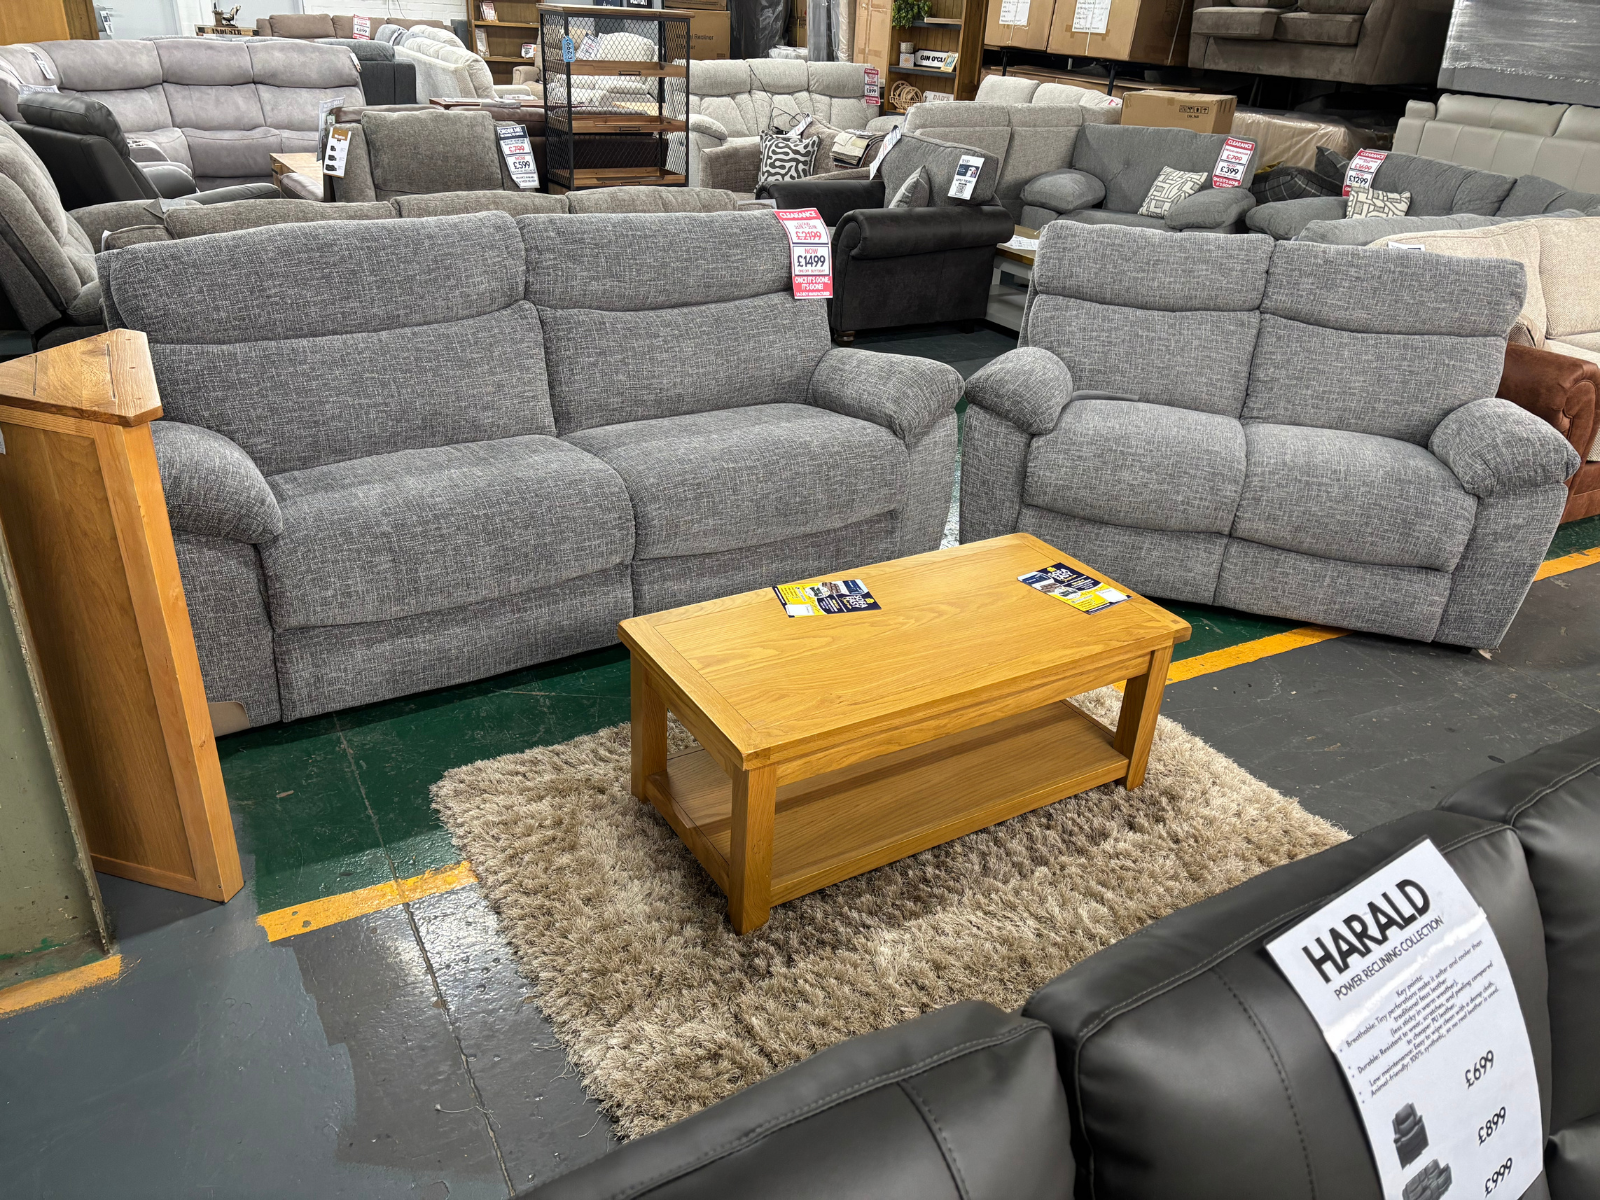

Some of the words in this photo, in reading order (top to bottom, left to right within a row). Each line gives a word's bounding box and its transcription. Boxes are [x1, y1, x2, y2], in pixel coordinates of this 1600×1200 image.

[1228, 140, 1252, 149] CLEARANCE
[513, 161, 530, 169] £599
[1221, 166, 1239, 175] £399
[1349, 175, 1368, 185] £1299
[1354, 163, 1372, 171] £1699
[796, 231, 821, 240] £2199
[797, 255, 825, 267] £1499
[1302, 879, 1430, 984] HARALD
[1334, 974, 1367, 1000] POWER
[1362, 946, 1403, 980] RECLINING
[1400, 916, 1444, 952] COLLECTION
[1346, 1022, 1377, 1048] Breathable:
[1375, 1014, 1388, 1024] Tiny
[1388, 991, 1417, 1018] perforations
[1418, 981, 1431, 993] make
[1435, 967, 1448, 979] softer
[1449, 957, 1458, 969] and
[1458, 948, 1471, 961] cooler
[1472, 940, 1483, 950] than
[1394, 998, 1419, 1022] traditional
[1419, 992, 1431, 1002] faux
[1430, 978, 1447, 993] leather
[1396, 988, 1407, 998] Key
[1407, 975, 1423, 992] points:
[1358, 1054, 1380, 1074] Durable:
[1380, 1034, 1403, 1056] Resistant
[1409, 1020, 1423, 1032] wear,
[1423, 1002, 1445, 1021] scratches,
[1446, 991, 1455, 1003] and
[1455, 980, 1472, 997] peeling
[1472, 960, 1493, 982] compared
[1390, 1025, 1402, 1038] (less
[1403, 1015, 1416, 1027] sticky
[1422, 998, 1436, 1011] warm
[1410, 1049, 1424, 1064] 100%
[1424, 1033, 1446, 1053] synthetic,
[1458, 1011, 1467, 1023] real
[1467, 1000, 1483, 1015] leather
[1488, 986, 1499, 999] used.
[1413, 1023, 1431, 1040] cheaper
[1431, 1015, 1438, 1025] PU
[1438, 1003, 1457, 1019] leather.
[1369, 1075, 1380, 1087] Low
[1382, 1048, 1414, 1077] maintenance:
[1413, 1039, 1425, 1050] Easy
[1431, 1024, 1442, 1035] wipe
[1443, 1014, 1455, 1026] clean
[1456, 1004, 1466, 1015] with
[1470, 991, 1482, 1004] damp
[1465, 1050, 1494, 1089] £699
[1478, 1106, 1506, 1146] £899
[1485, 1157, 1513, 1198] £999
